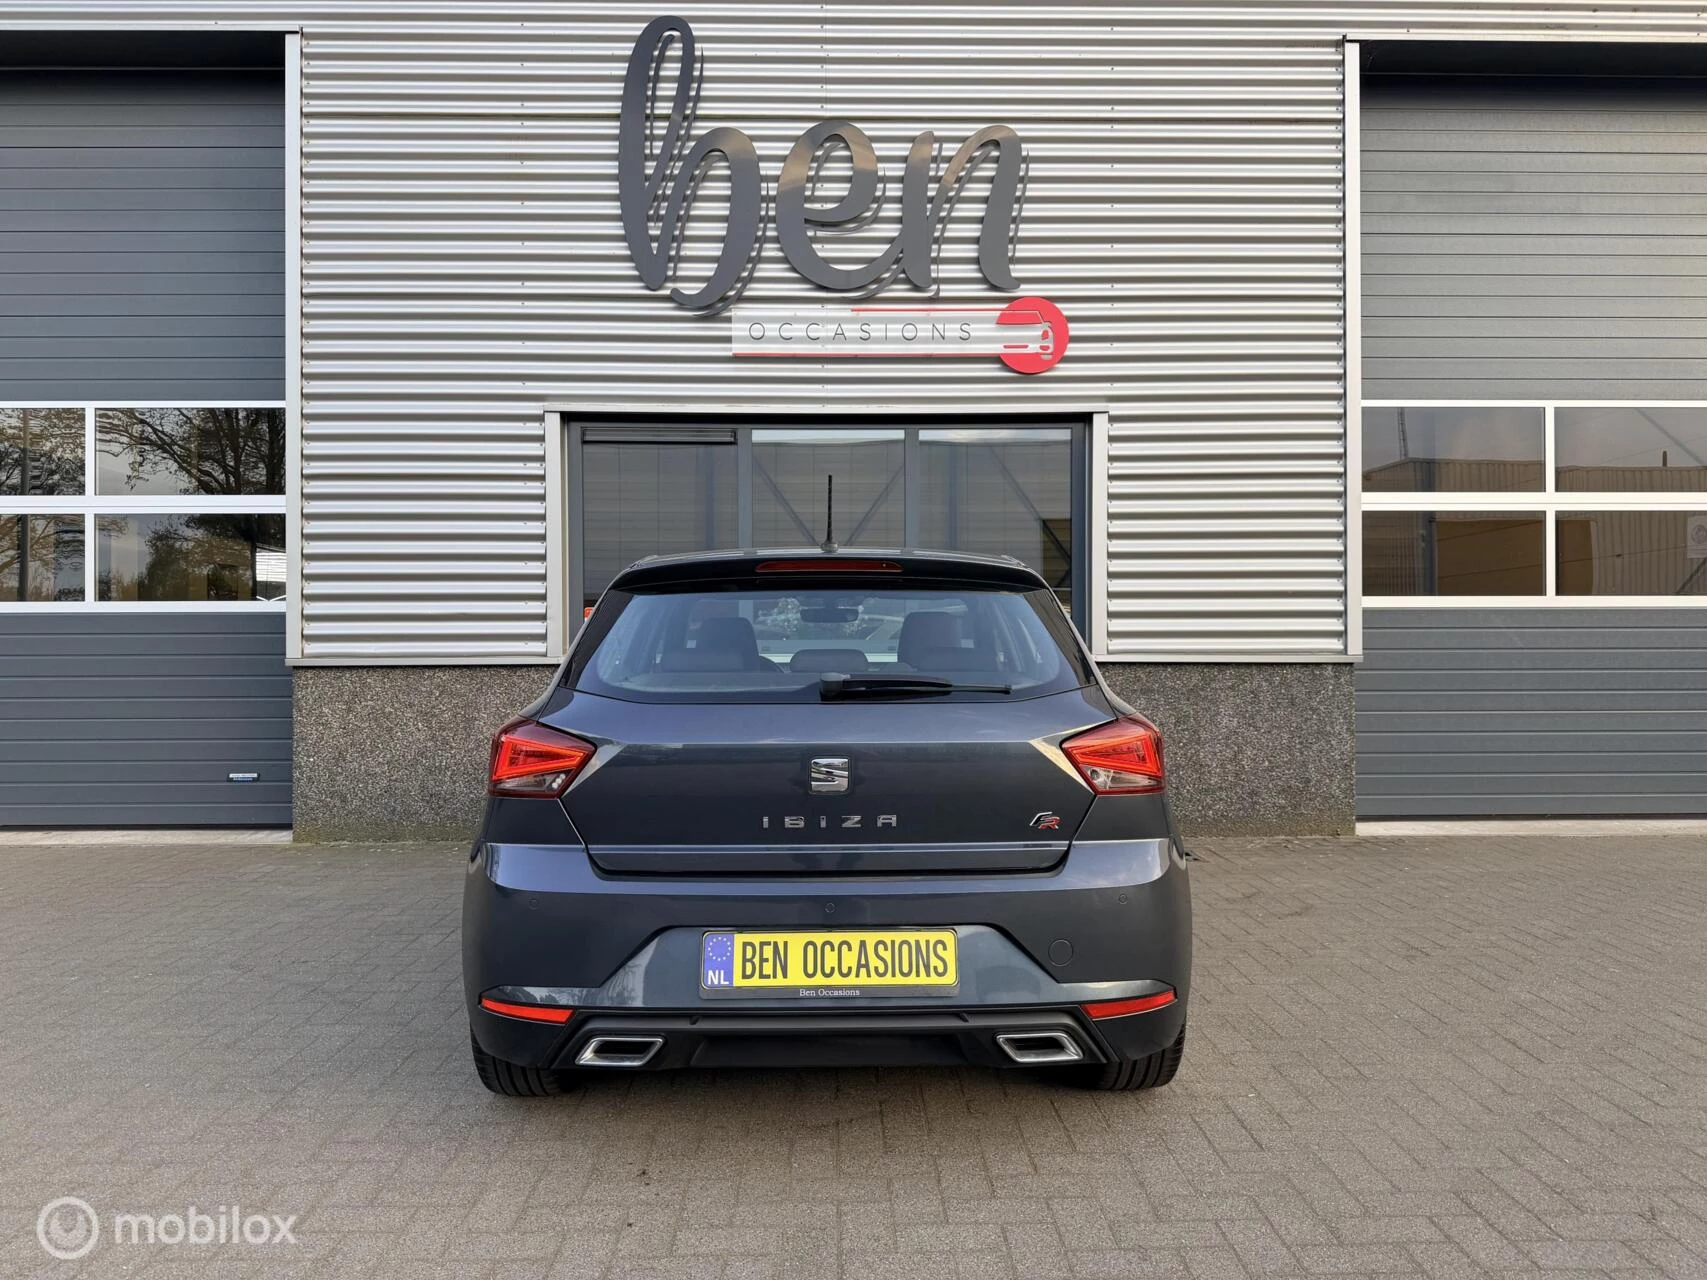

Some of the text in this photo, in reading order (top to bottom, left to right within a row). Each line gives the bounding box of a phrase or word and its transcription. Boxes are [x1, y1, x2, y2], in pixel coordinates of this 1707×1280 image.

[618, 15, 1024, 308] ben
[748, 322, 972, 341] OCCASIONS
[741, 938, 949, 980] BEN OCCASIONS
[707, 969, 730, 986] NL
[799, 988, 860, 997] Ben Occasions
